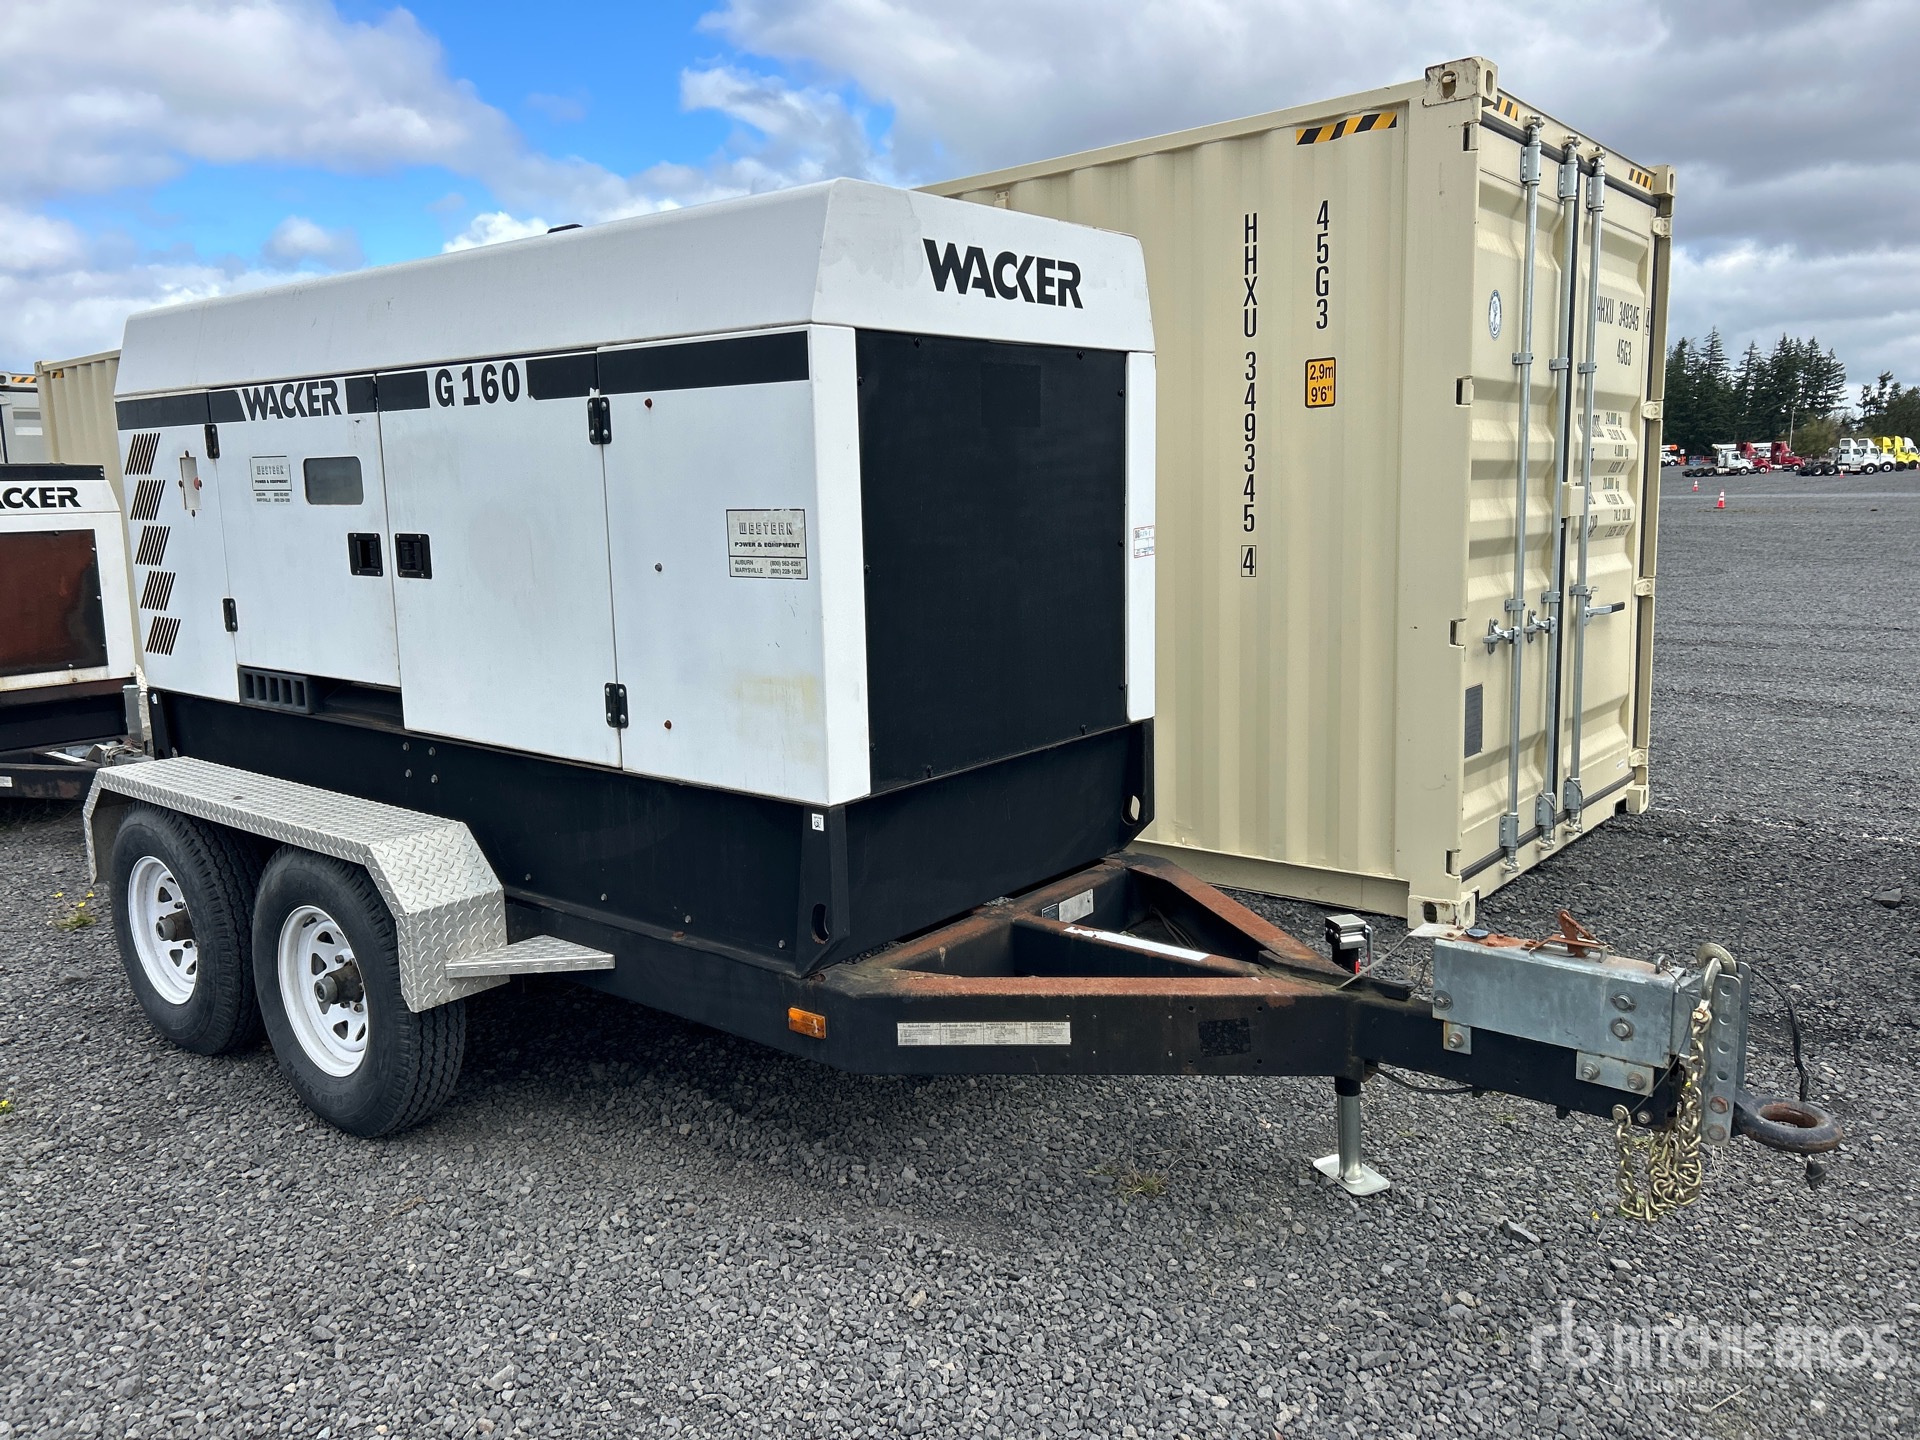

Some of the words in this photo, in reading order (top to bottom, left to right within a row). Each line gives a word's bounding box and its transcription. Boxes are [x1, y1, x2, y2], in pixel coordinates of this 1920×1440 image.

[922, 238, 1083, 309] WACKER
[1243, 212, 1258, 337] HHXU
[1316, 200, 1329, 329] 45G3
[1619, 301, 1639, 331] 349345
[1617, 339, 1632, 366] 45G3
[461, 362, 520, 406] 160
[1309, 363, 1334, 383] 2,9m
[242, 379, 342, 421] WACKER
[1243, 351, 1257, 532] 349345
[0, 486, 82, 510] CKER
[738, 522, 793, 536] WESTERN
[1242, 547, 1255, 575] 4
